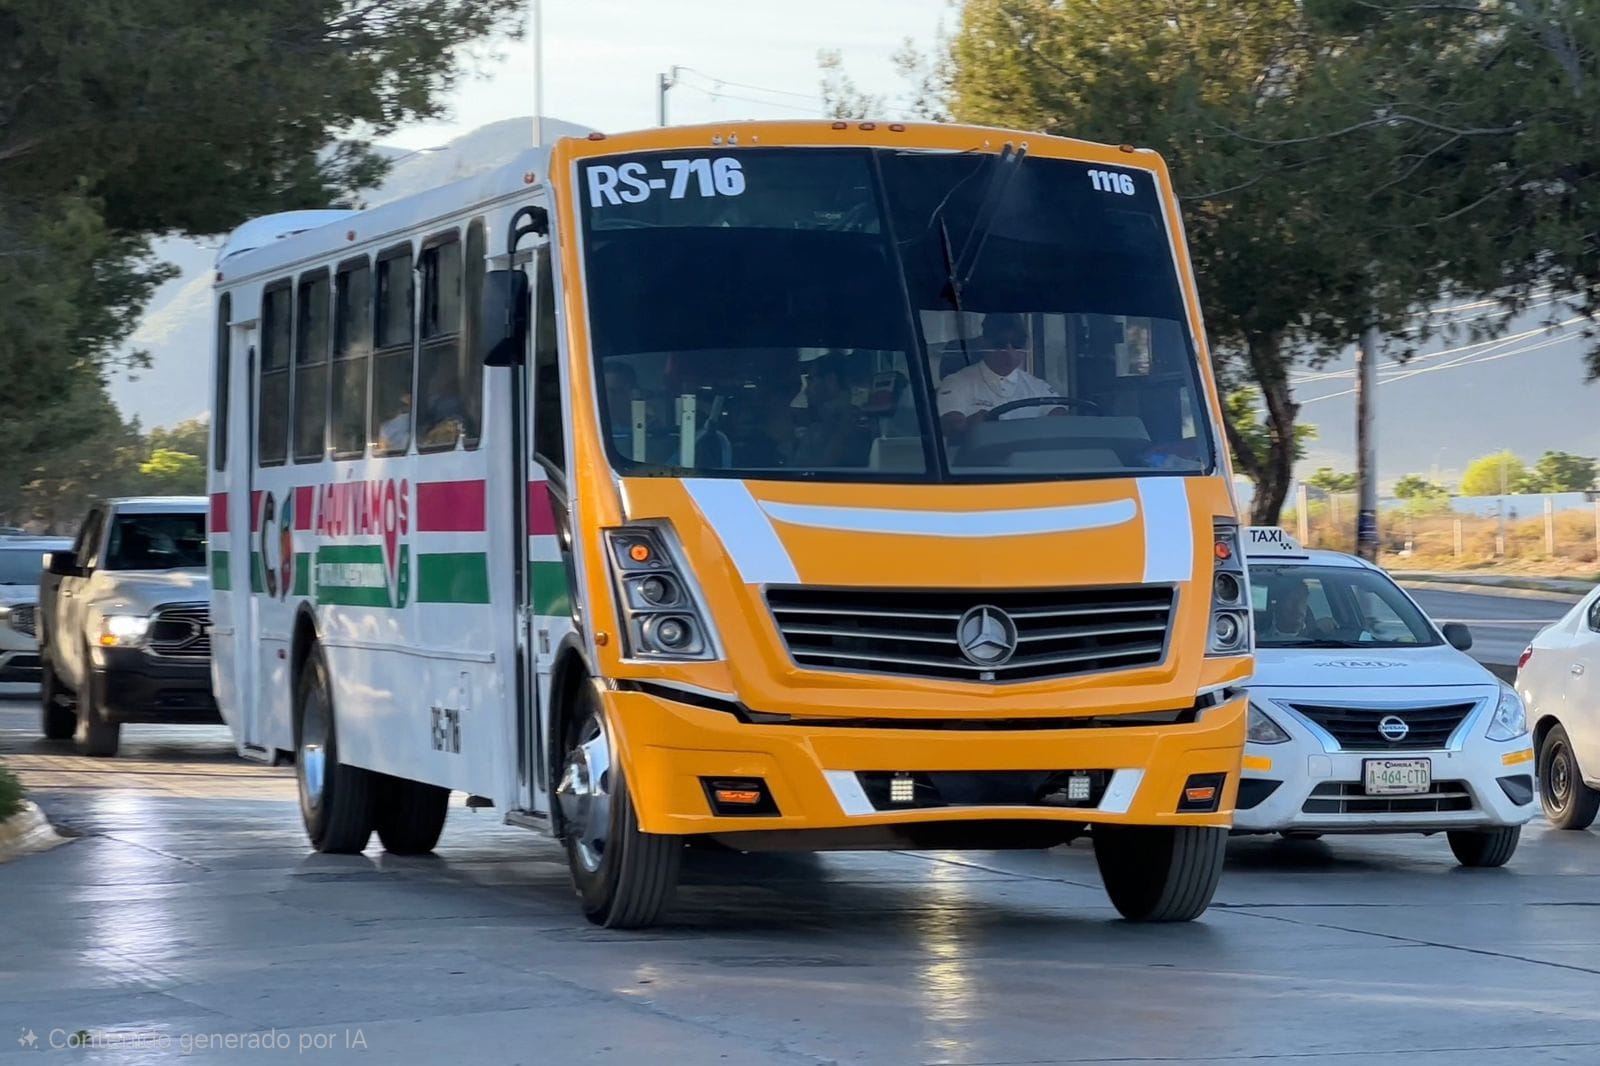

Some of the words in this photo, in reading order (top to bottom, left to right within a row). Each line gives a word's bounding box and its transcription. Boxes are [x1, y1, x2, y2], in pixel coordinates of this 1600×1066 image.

[586, 156, 746, 208] RS-716
[1087, 169, 1135, 196] 1116
[1249, 529, 1282, 543] TAXI
